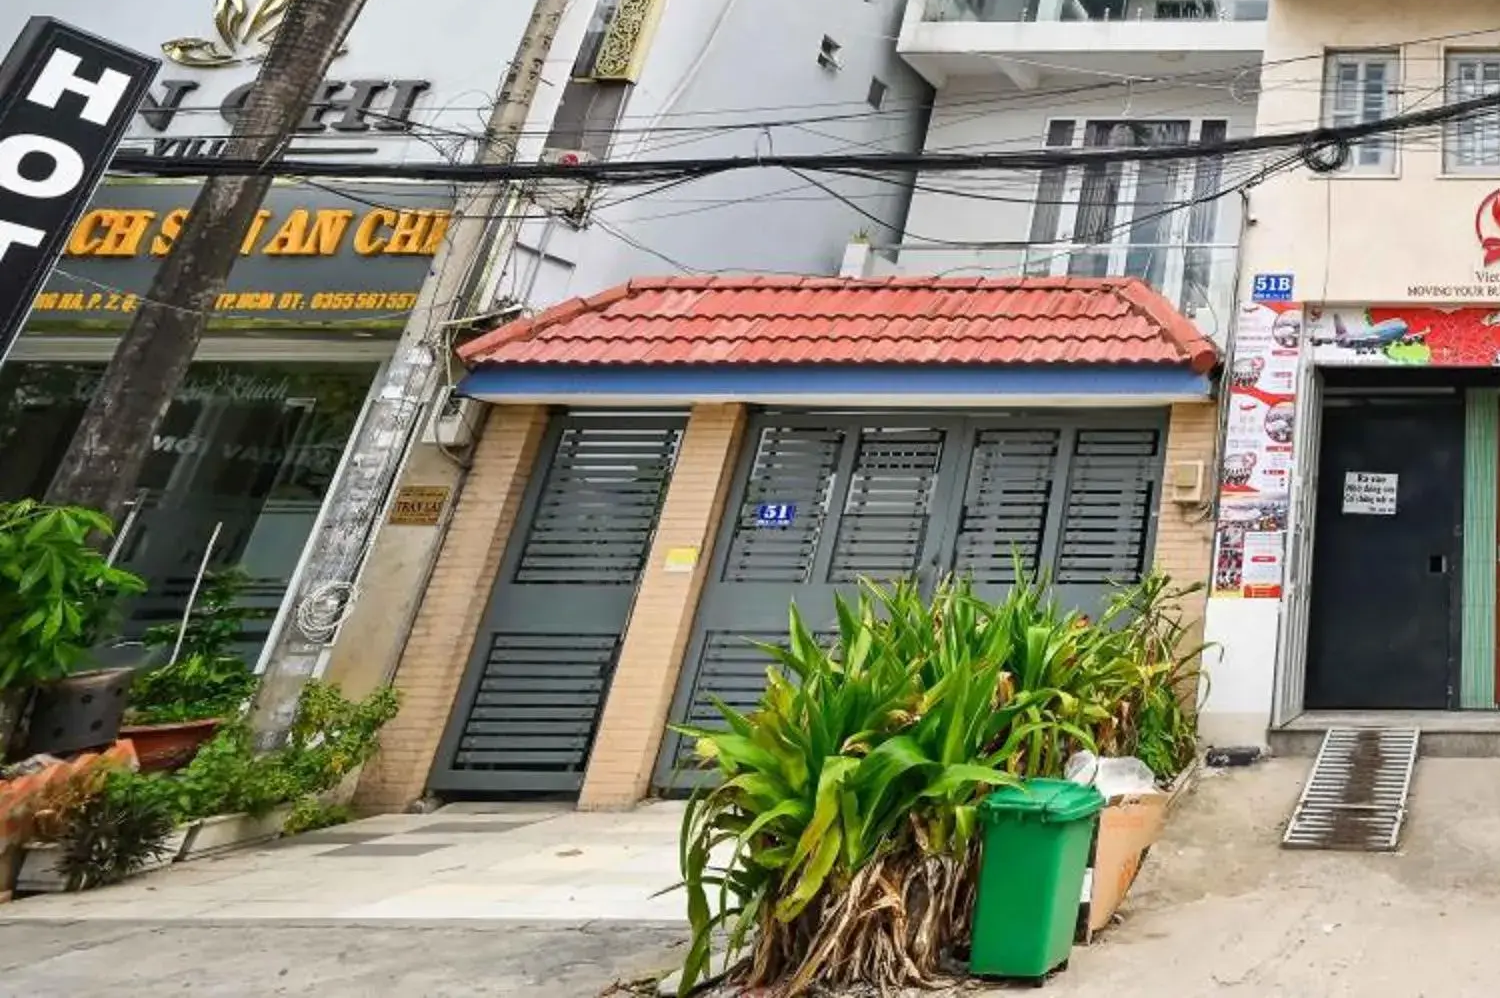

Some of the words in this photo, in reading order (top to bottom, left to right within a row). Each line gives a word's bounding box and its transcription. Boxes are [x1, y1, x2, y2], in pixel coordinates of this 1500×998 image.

[139, 79, 200, 132] N
[262, 209, 353, 257] AN
[1256, 277, 1291, 292] 51B
[1407, 285, 1451, 298] MOVING
[1454, 285, 1485, 298] YOUR
[764, 505, 787, 519] 51
